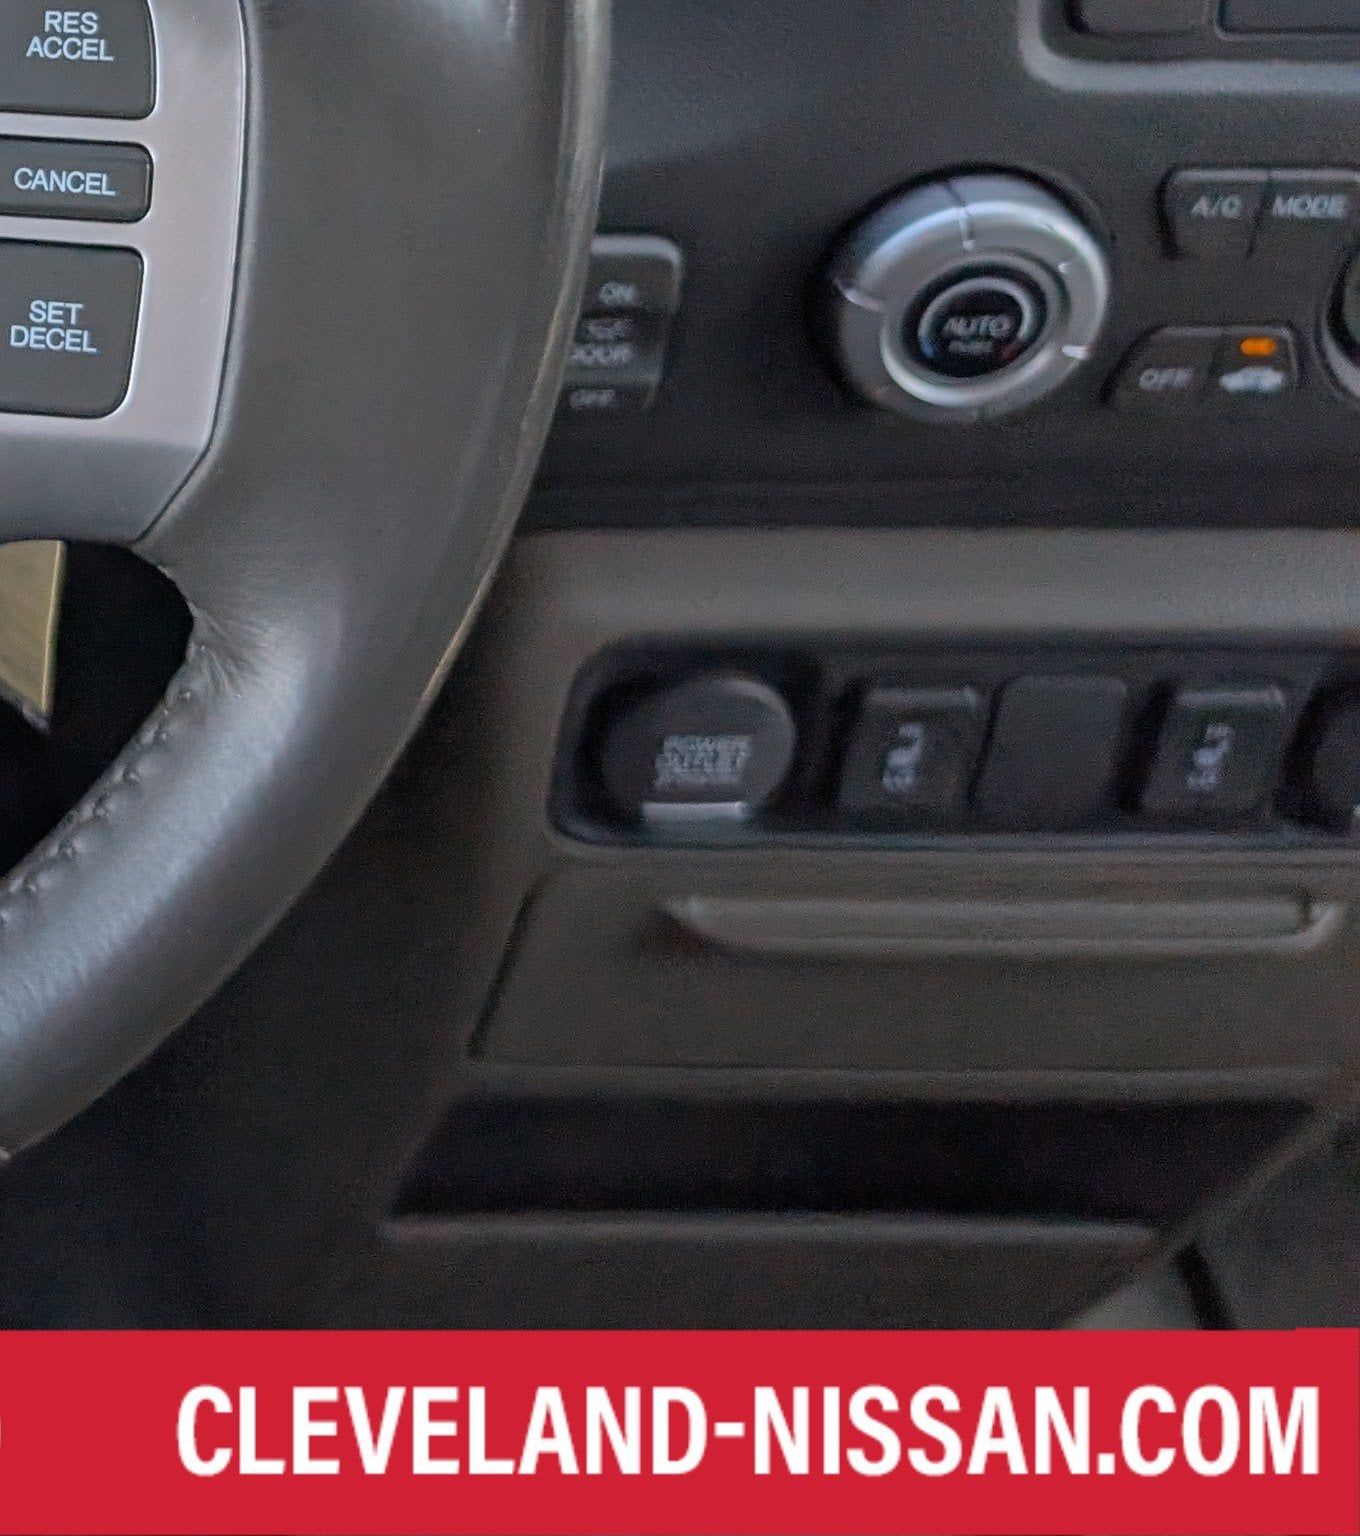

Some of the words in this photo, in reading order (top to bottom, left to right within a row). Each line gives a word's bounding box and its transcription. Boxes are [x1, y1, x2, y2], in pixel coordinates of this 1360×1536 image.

[44, 10, 99, 36] RES
[25, 36, 114, 62] ACCEL
[13, 166, 116, 196] CANCEL
[28, 299, 84, 325] SET
[9, 324, 98, 354] DECEL
